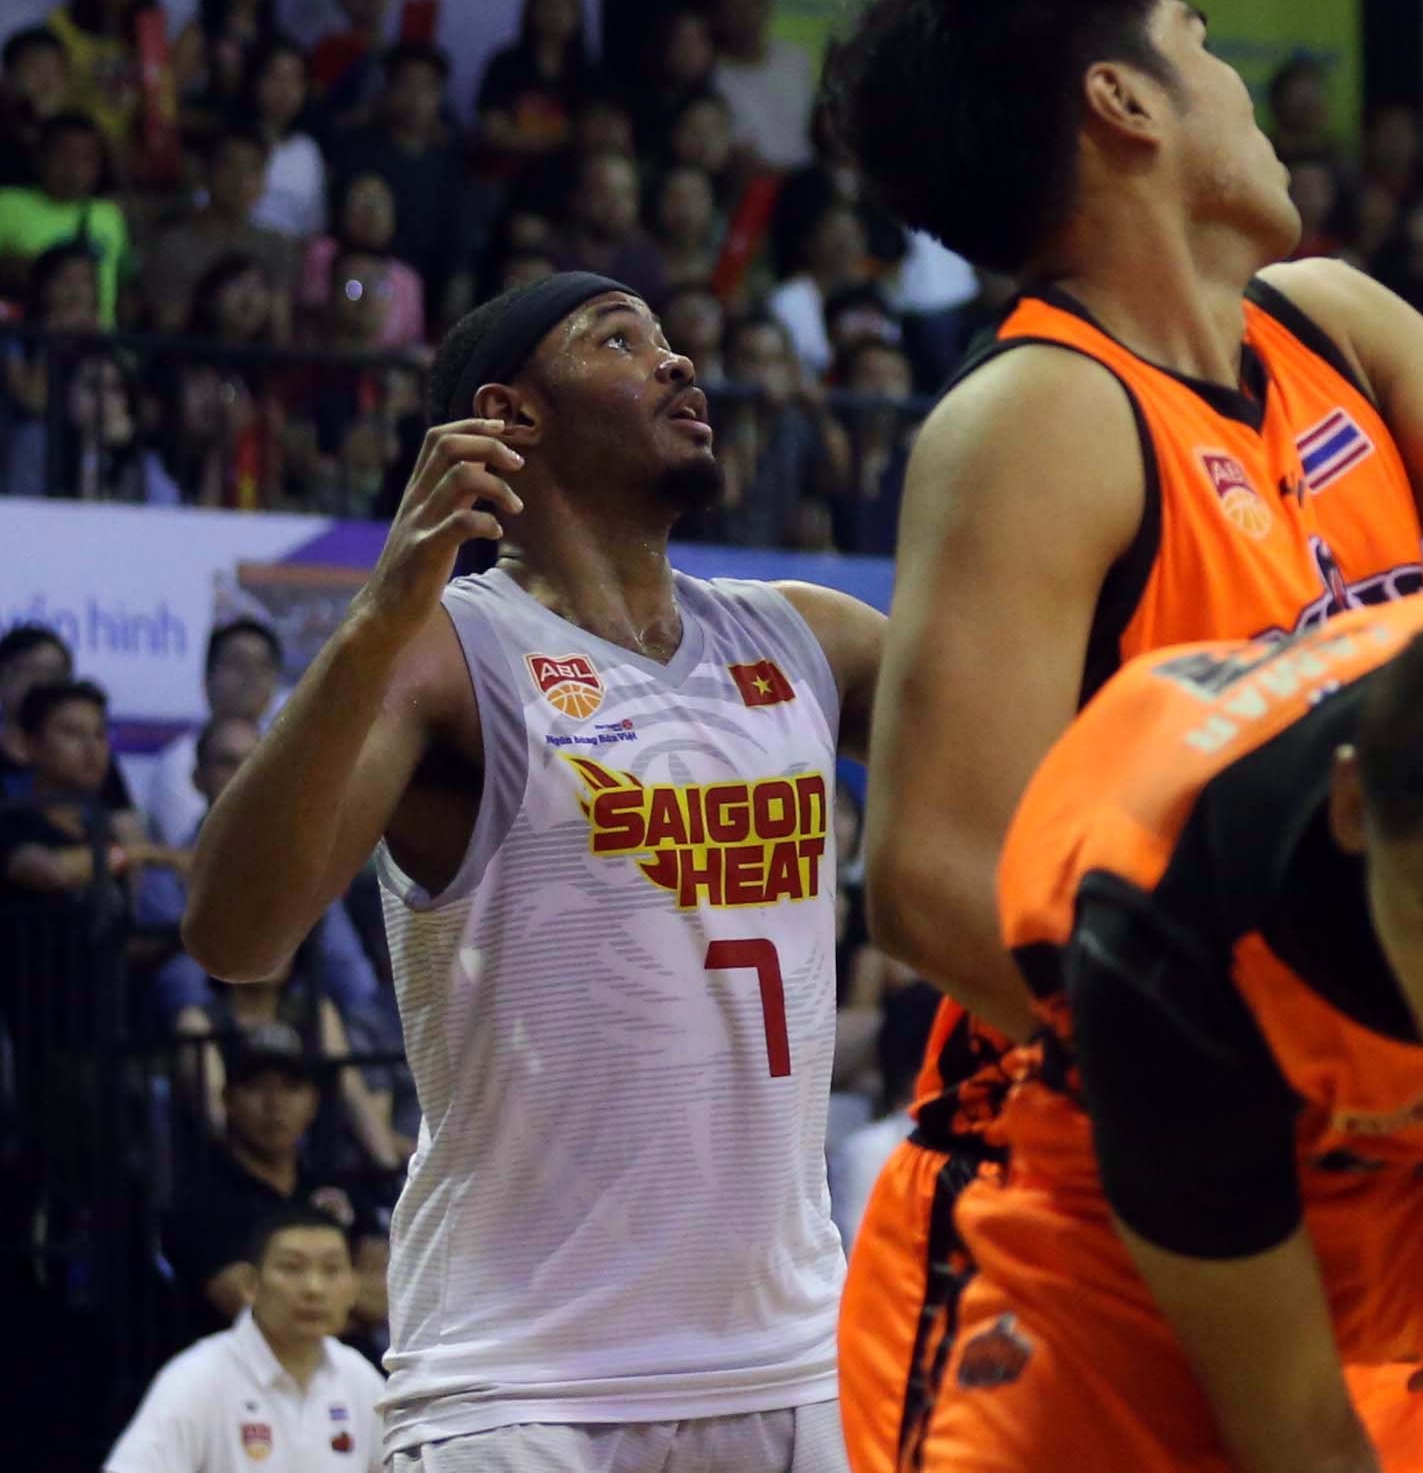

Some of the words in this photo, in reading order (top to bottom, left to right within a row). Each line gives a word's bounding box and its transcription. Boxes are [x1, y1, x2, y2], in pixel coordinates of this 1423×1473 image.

[541, 662, 594, 683] ABL
[592, 773, 828, 854] SAIGON
[676, 837, 826, 909] HEAT
[703, 937, 792, 1079] 7
